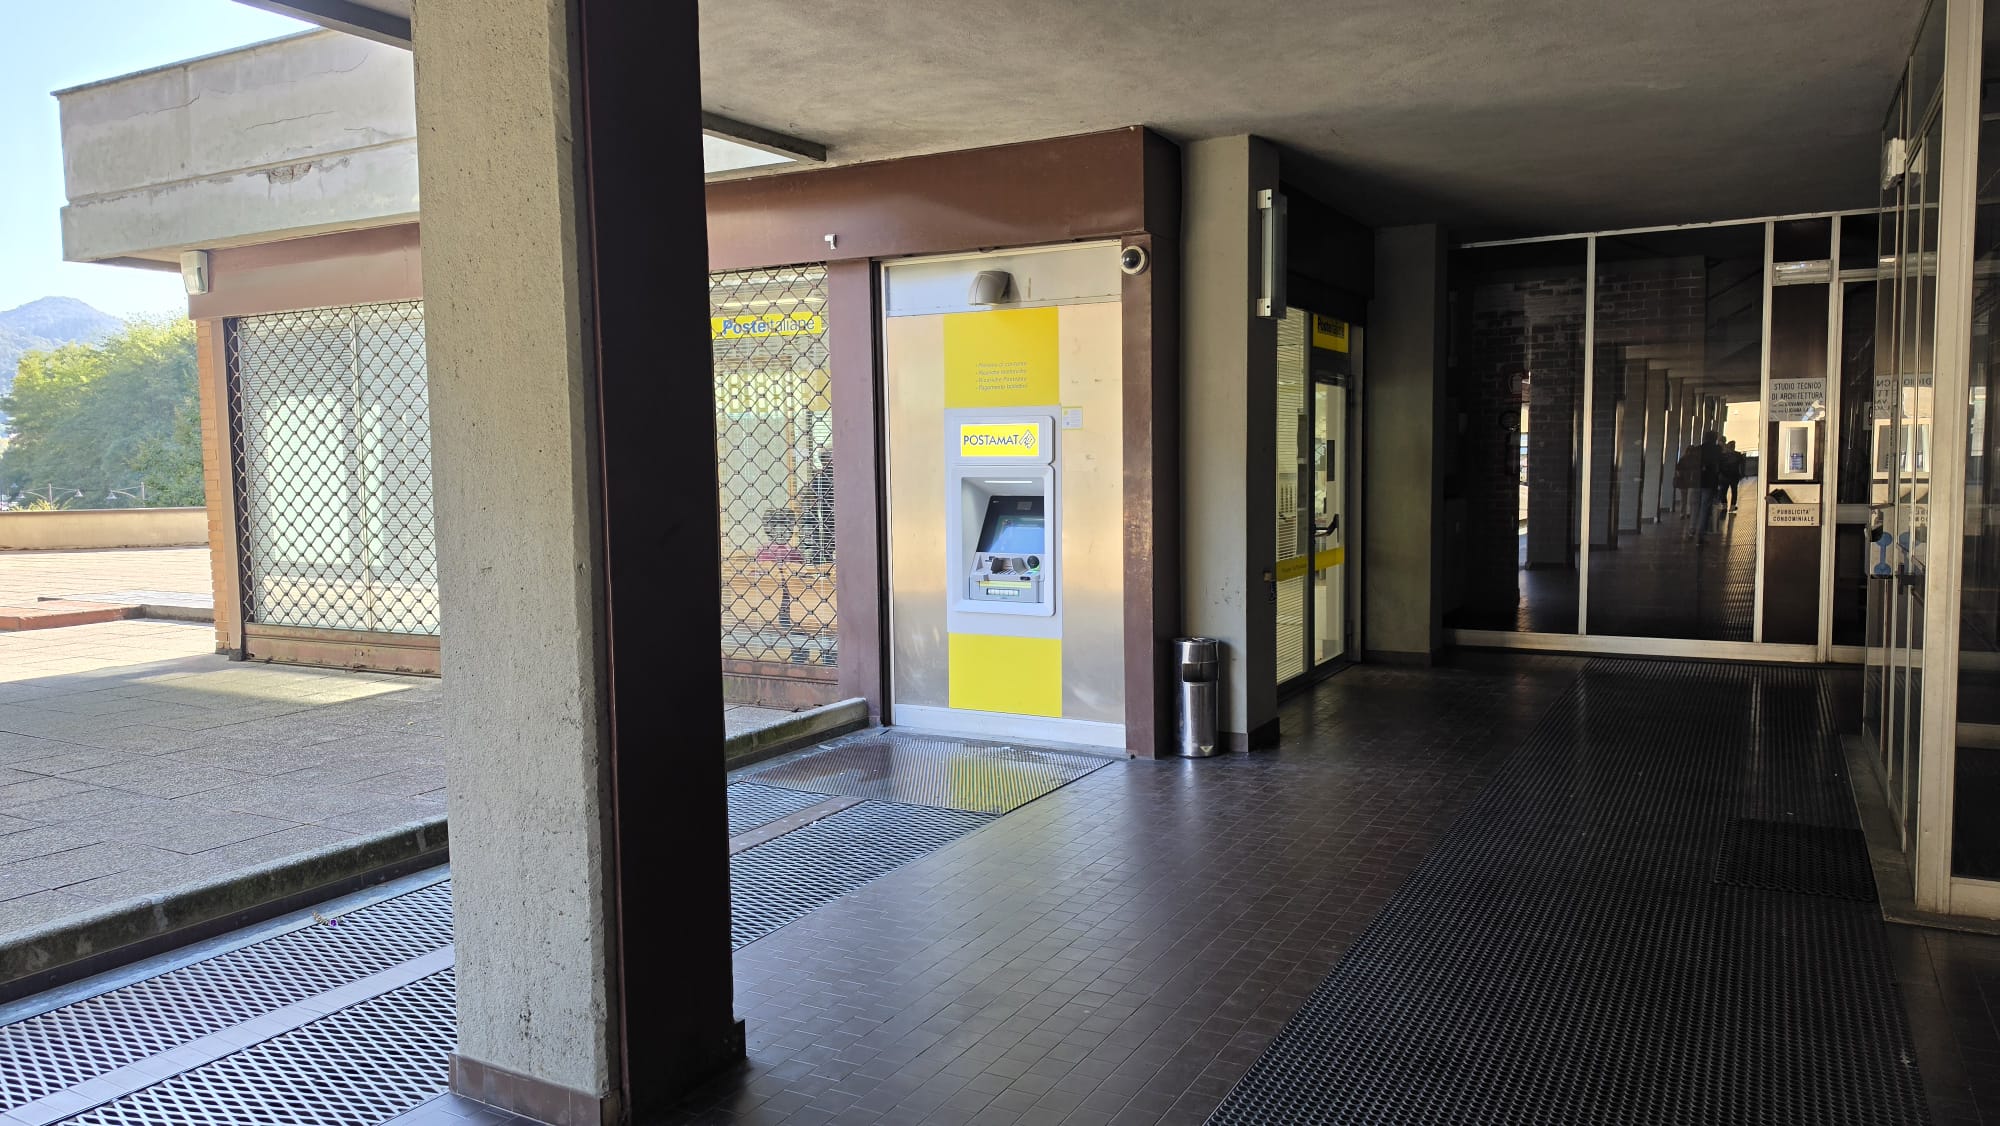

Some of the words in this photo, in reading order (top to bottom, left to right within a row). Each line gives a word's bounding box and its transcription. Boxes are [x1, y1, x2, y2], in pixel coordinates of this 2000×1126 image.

[1797, 382, 1822, 390] TECNICO
[1780, 391, 1824, 400] ARCHITETTURA
[963, 434, 1019, 446] POSTAMAT
